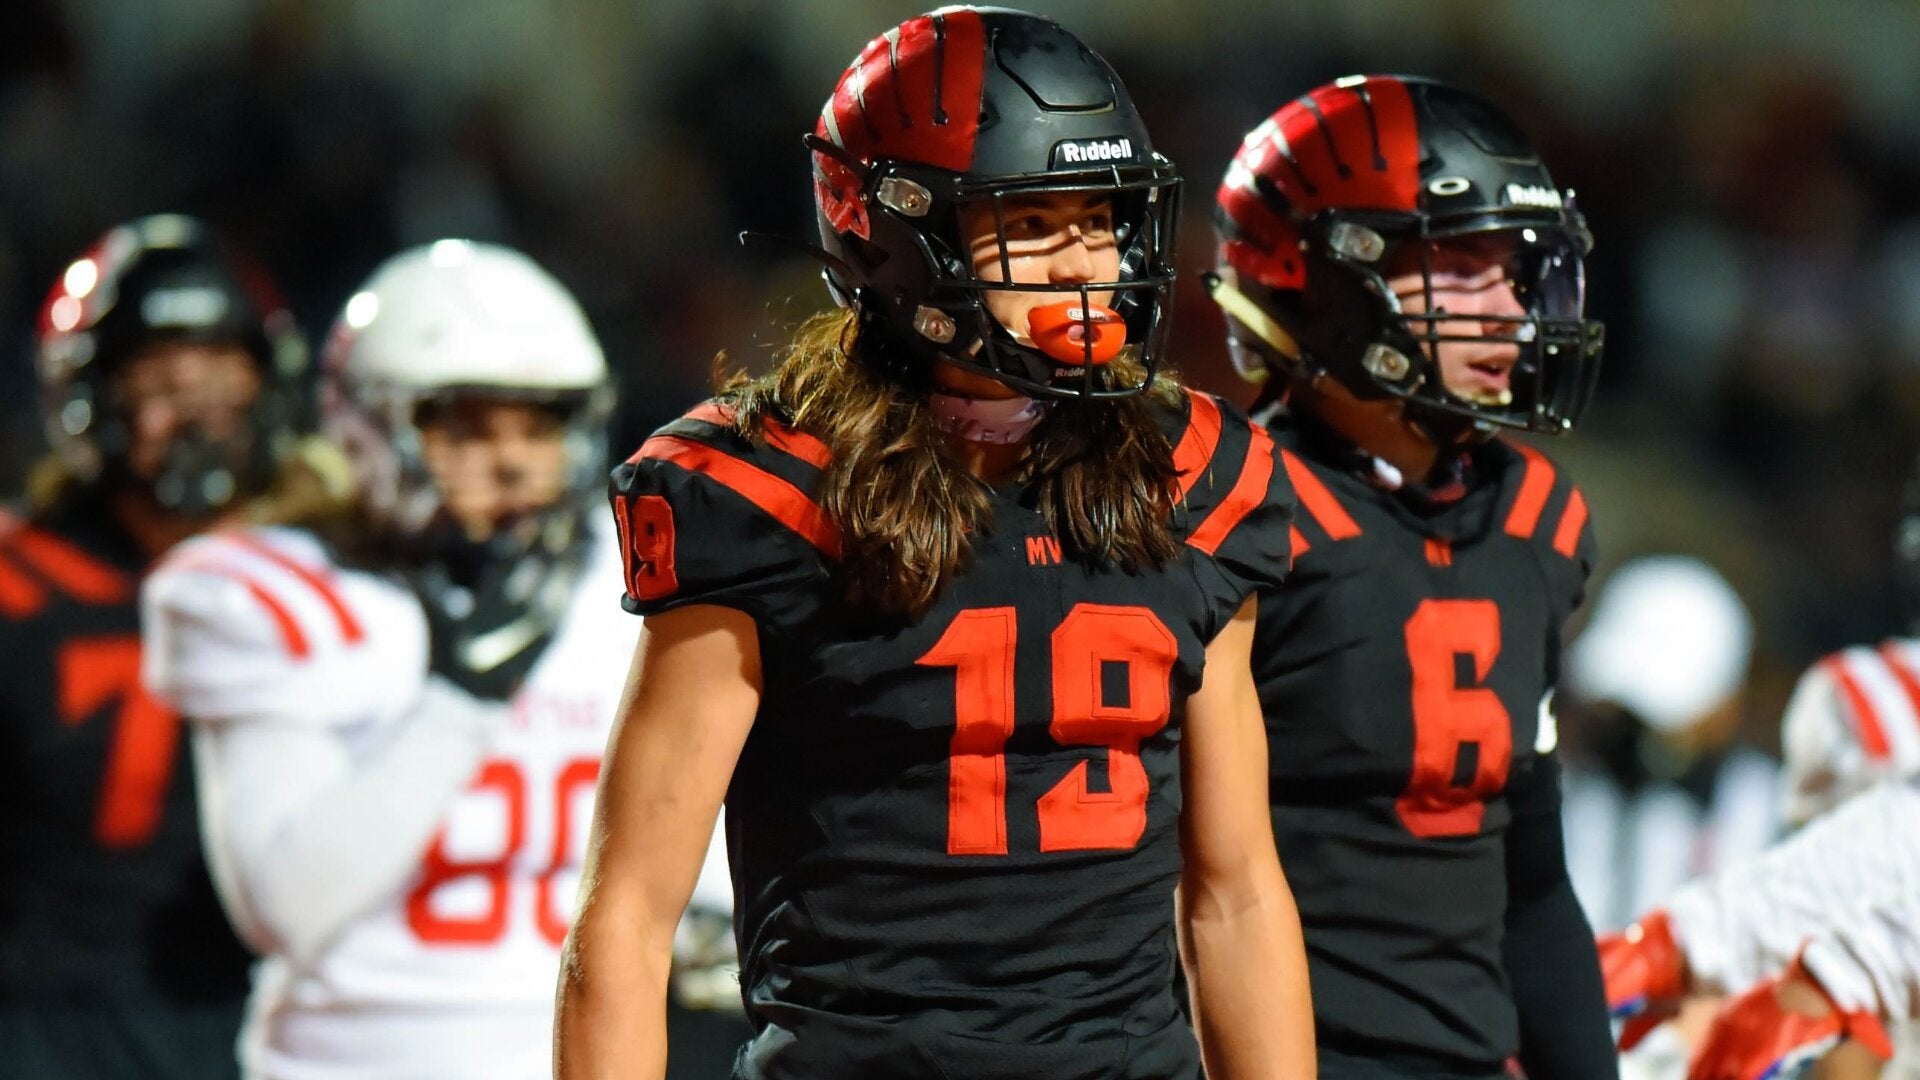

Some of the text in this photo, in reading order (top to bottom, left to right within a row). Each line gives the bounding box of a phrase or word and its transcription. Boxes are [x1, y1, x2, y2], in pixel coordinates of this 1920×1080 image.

[1062, 139, 1132, 162] Riddell
[1055, 368, 1085, 377] Ridde
[616, 495, 679, 600] 19
[1025, 535, 1062, 566] MV
[57, 634, 183, 849] 7
[914, 602, 1178, 855] 19
[1396, 598, 1512, 839] 6
